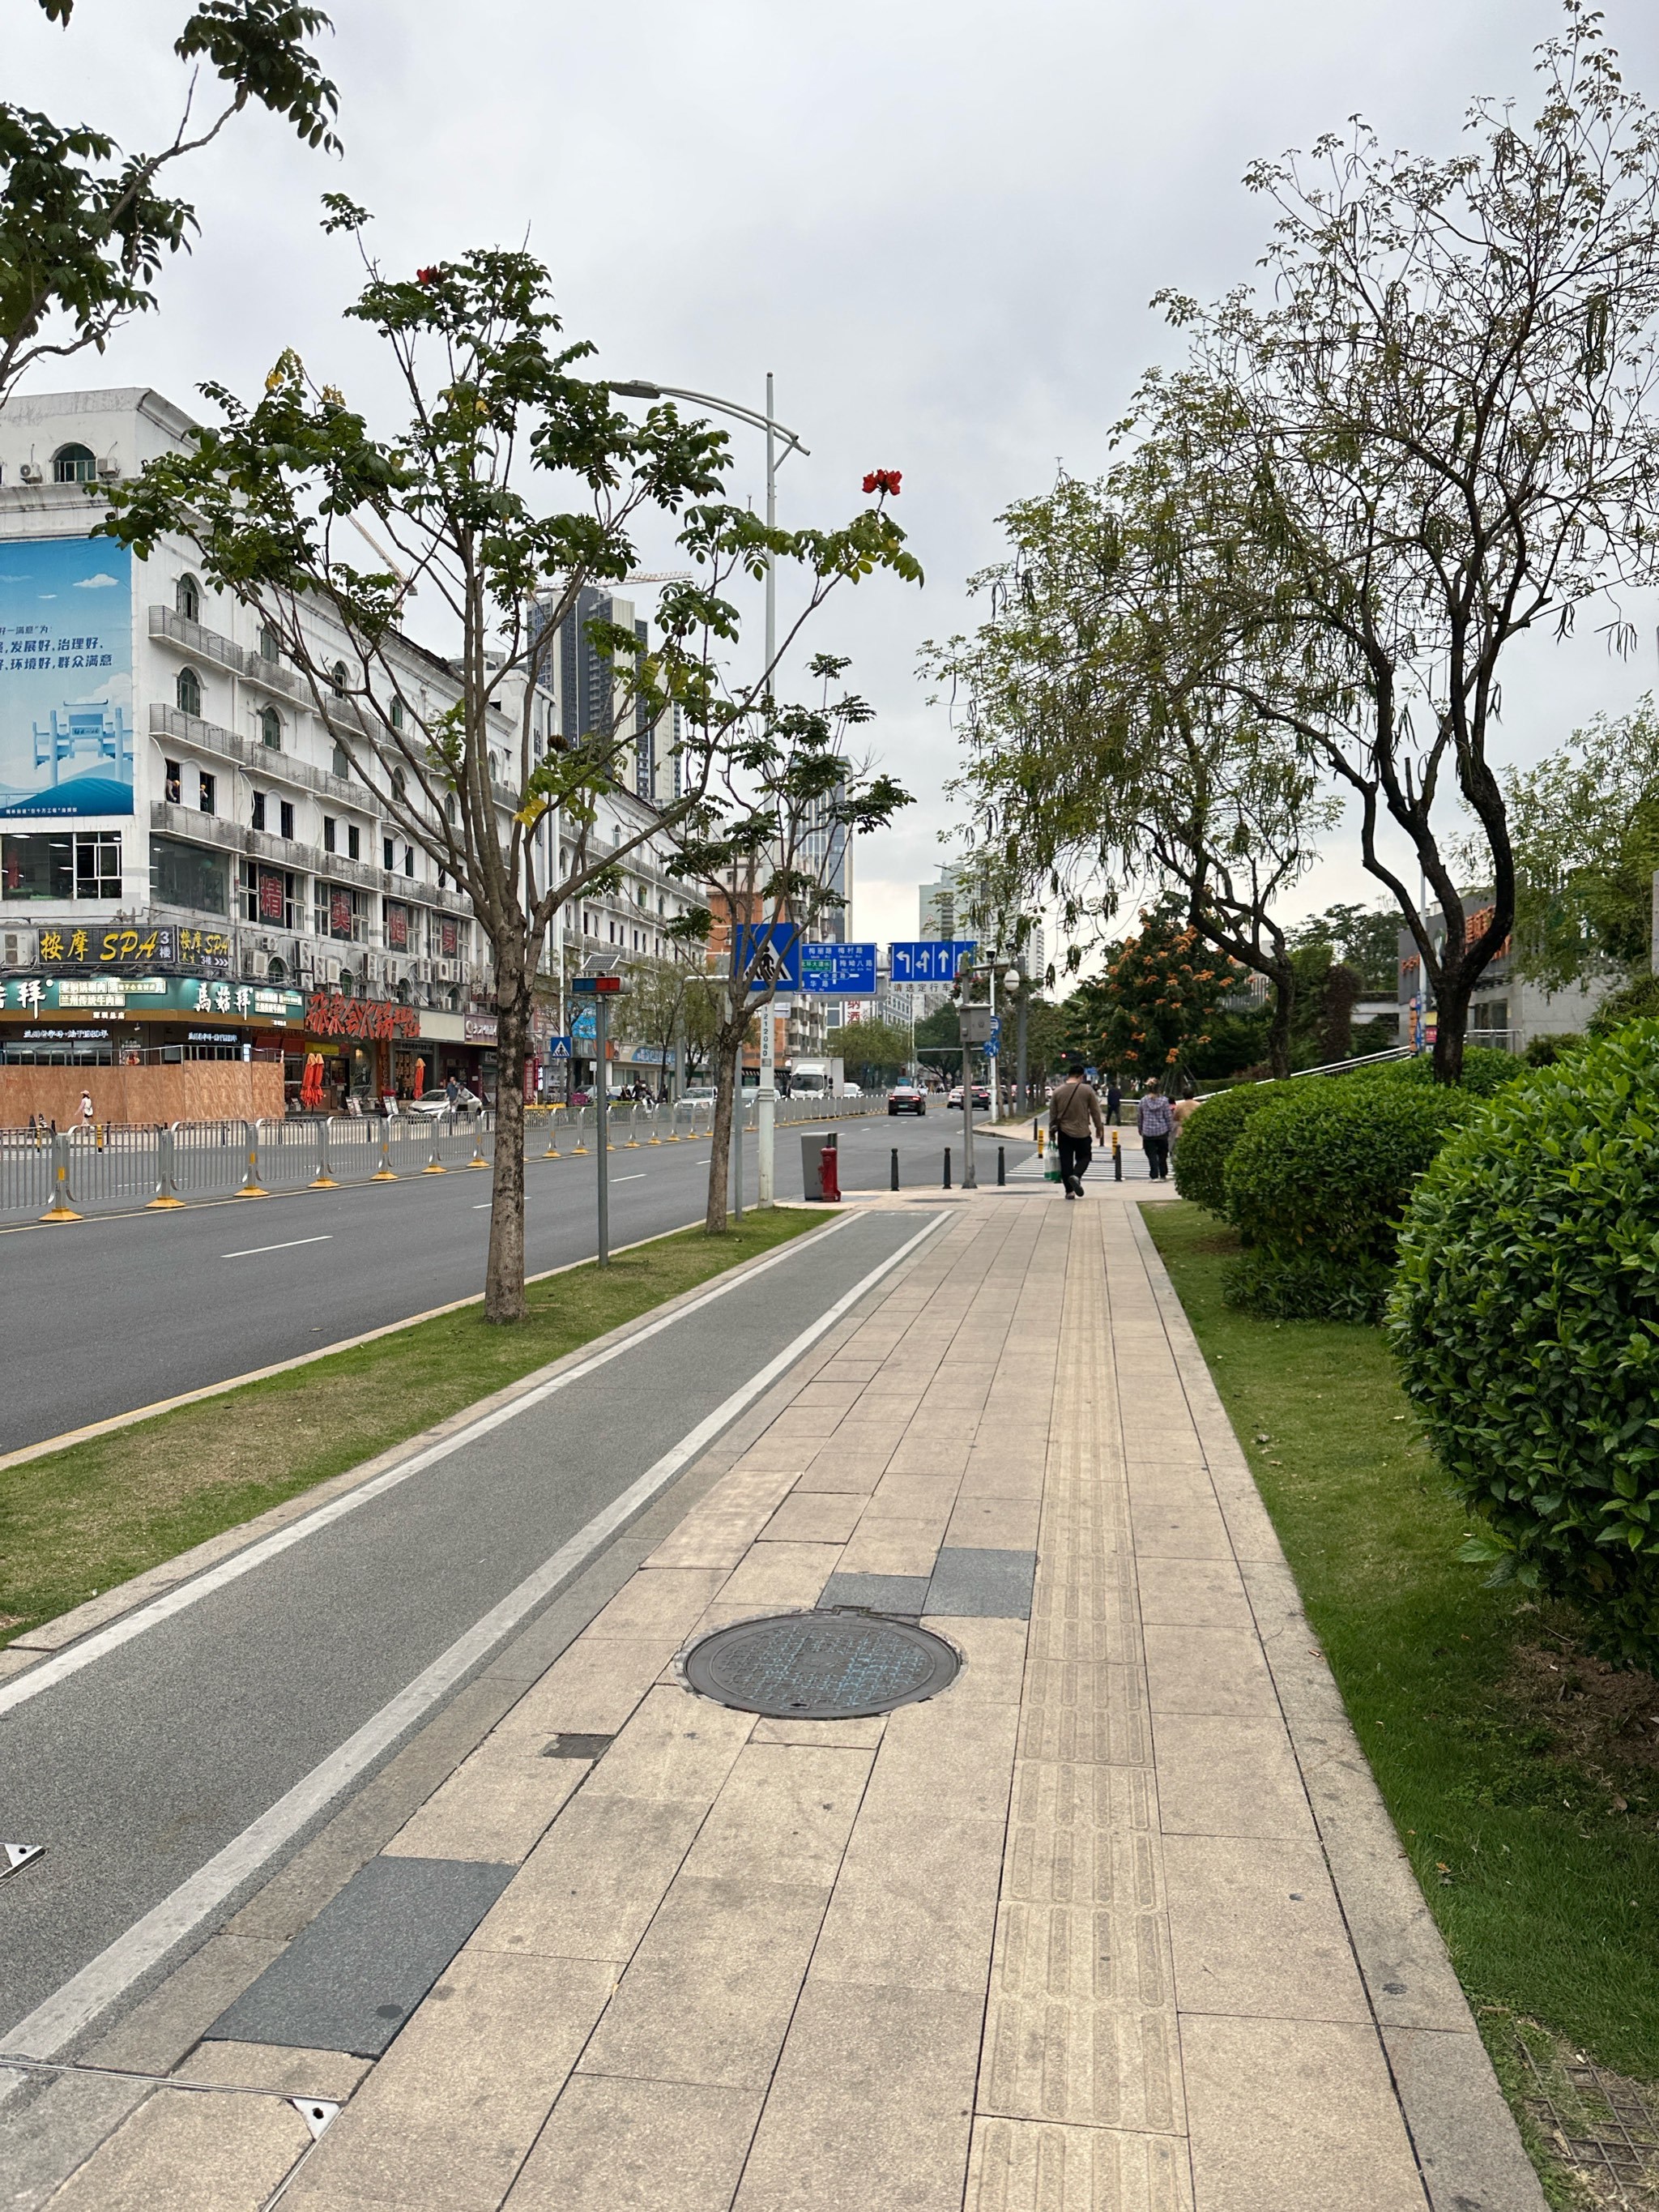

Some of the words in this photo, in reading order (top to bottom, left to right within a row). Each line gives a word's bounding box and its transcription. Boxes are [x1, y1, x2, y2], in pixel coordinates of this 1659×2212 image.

[41, 929, 90, 962] 按摩
[100, 931, 159, 961] SPA
[204, 934, 228, 955] SPA
[893, 983, 951, 993] 请选定行车
